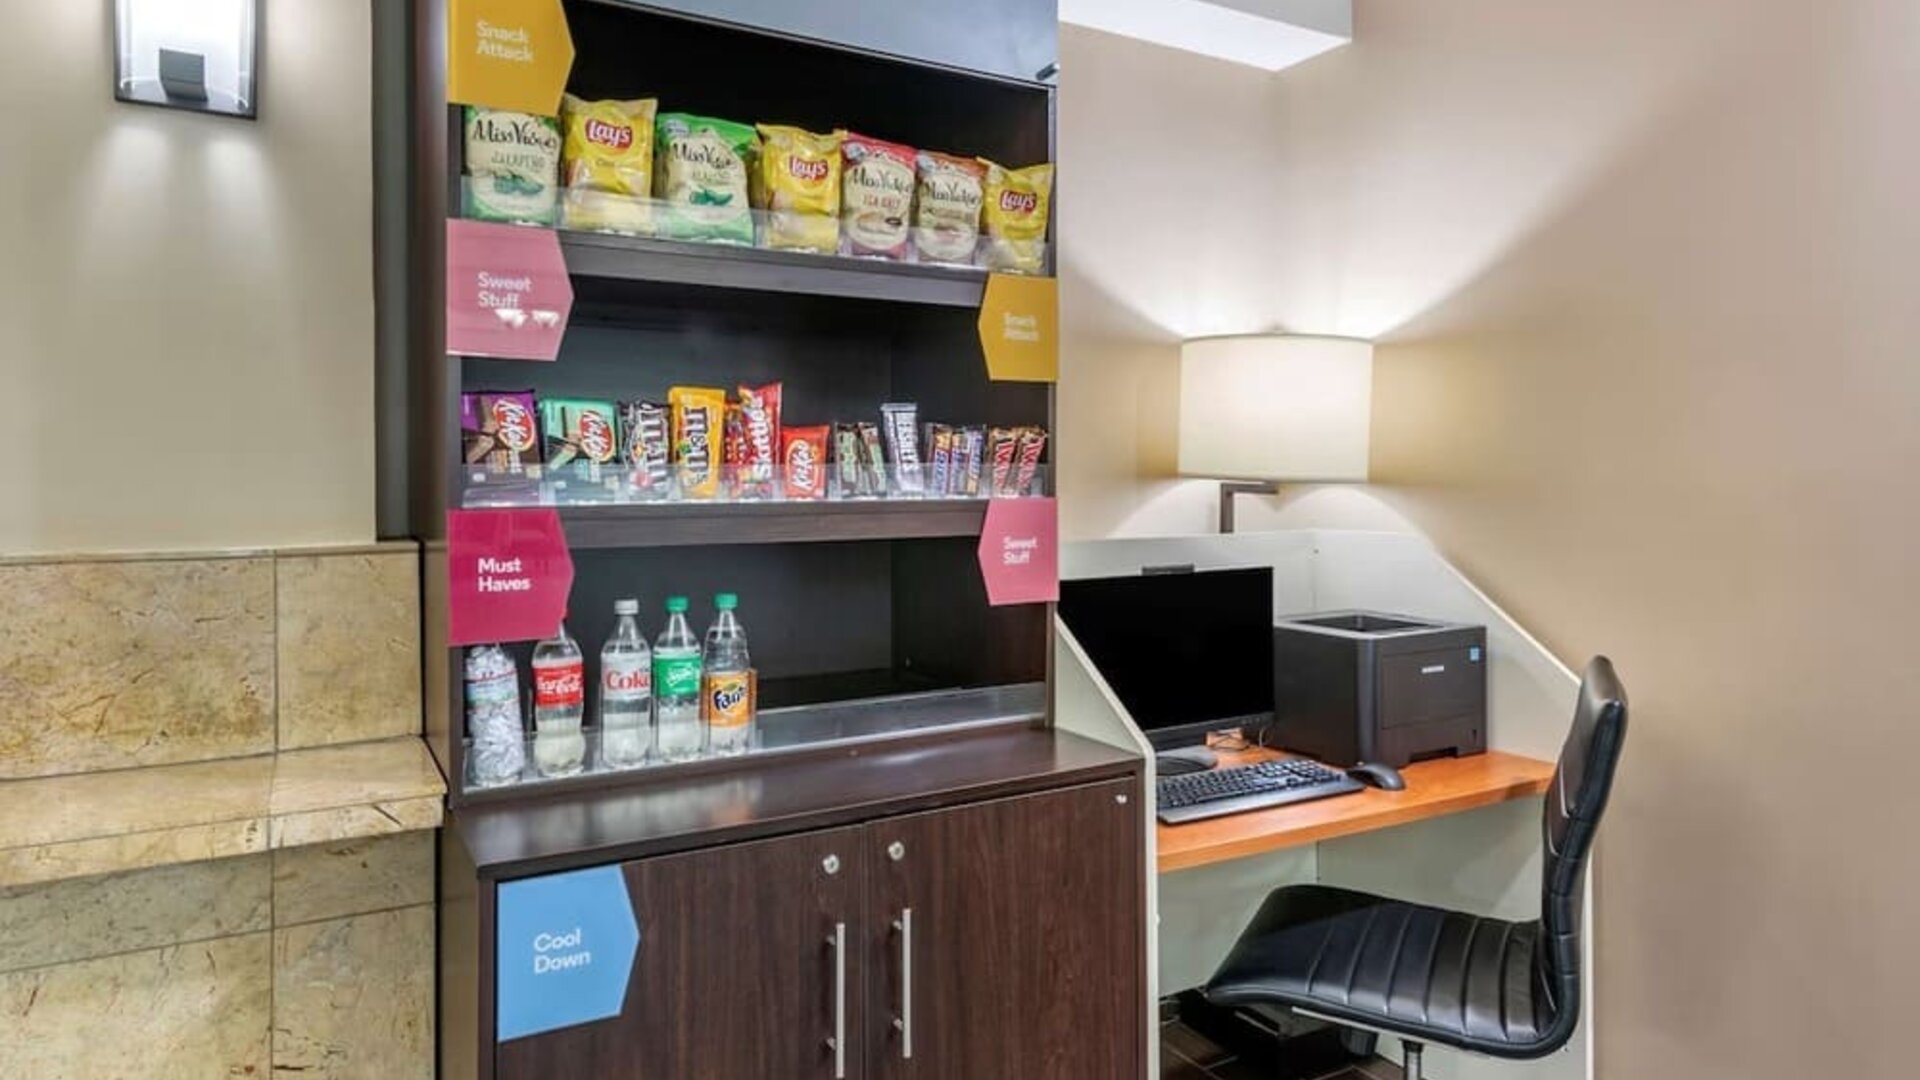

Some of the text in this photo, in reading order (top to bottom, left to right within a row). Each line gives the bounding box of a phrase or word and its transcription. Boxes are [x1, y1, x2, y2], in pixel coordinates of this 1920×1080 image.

[476, 20, 529, 43] Snack
[476, 40, 533, 62] Attack
[473, 119, 514, 143] Miss
[478, 271, 532, 292] Sweet
[478, 290, 519, 309] Stuff
[478, 557, 522, 574] Must
[478, 576, 531, 592] Haves
[713, 684, 748, 712] Fant
[534, 928, 581, 953] Cool
[534, 951, 591, 974] Down
